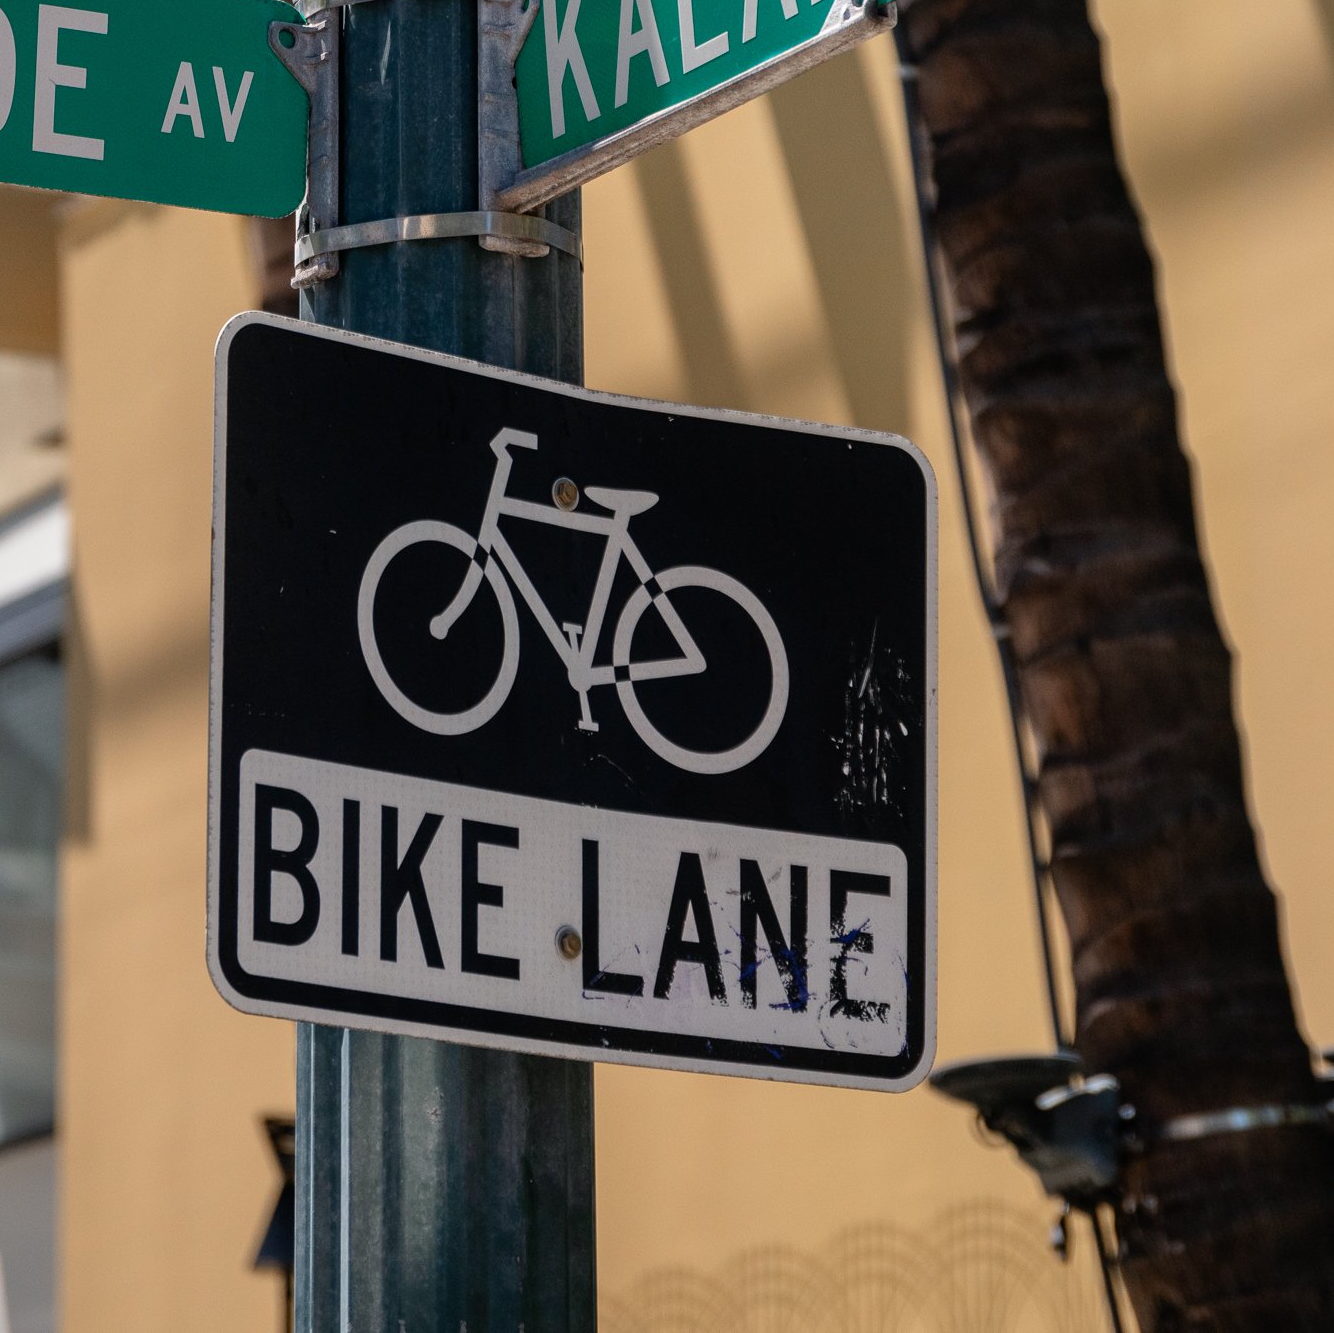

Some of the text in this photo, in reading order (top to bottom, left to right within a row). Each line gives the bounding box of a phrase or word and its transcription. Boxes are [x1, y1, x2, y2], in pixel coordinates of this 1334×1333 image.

[160, 60, 255, 144] AV
[252, 782, 892, 1023] BIKE LANE
